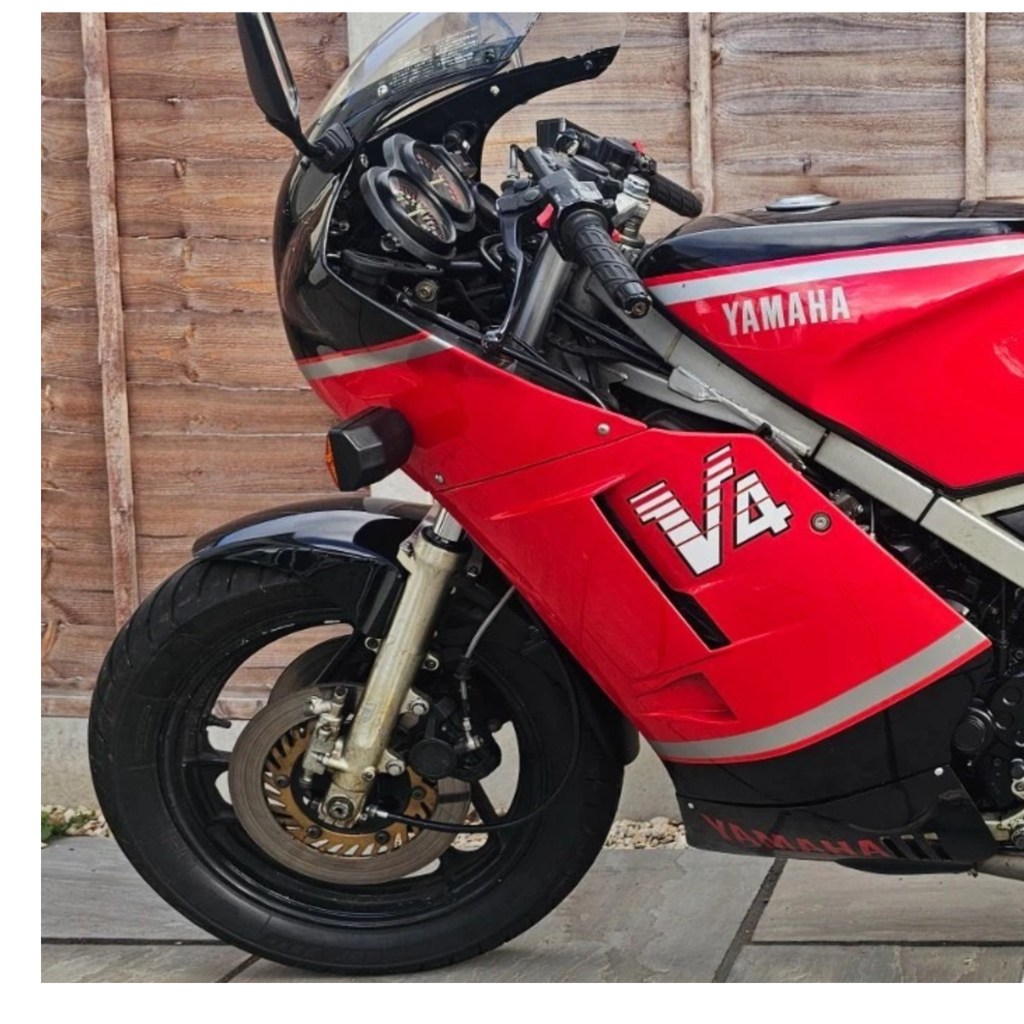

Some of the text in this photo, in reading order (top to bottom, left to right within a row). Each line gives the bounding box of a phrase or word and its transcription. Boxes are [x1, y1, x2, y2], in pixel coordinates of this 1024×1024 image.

[721, 285, 851, 337] YAMAHA
[627, 442, 795, 577] V4
[701, 813, 893, 858] YAMAHA
